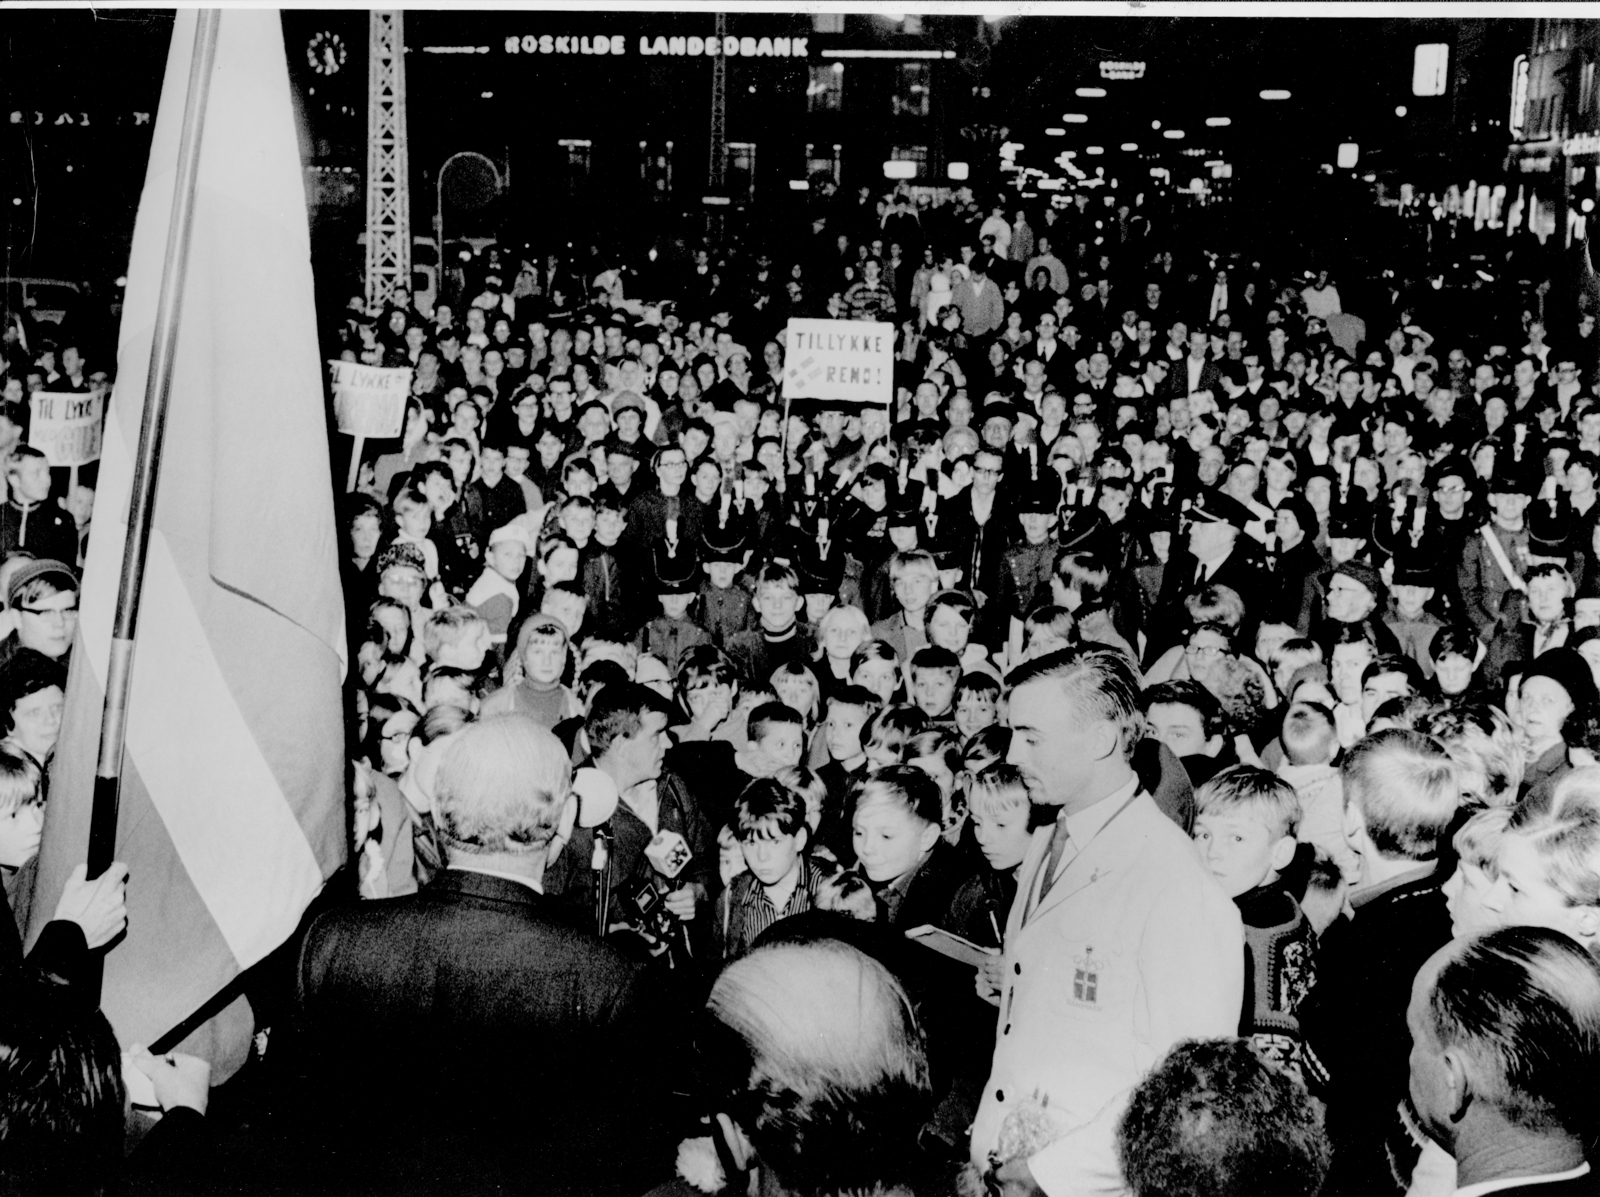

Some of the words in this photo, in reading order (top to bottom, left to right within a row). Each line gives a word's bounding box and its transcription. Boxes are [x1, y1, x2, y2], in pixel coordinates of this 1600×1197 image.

[505, 35, 626, 55] ROSKILDE
[796, 332, 882, 353] TILLYKKE
[350, 369, 392, 390] LYKKE
